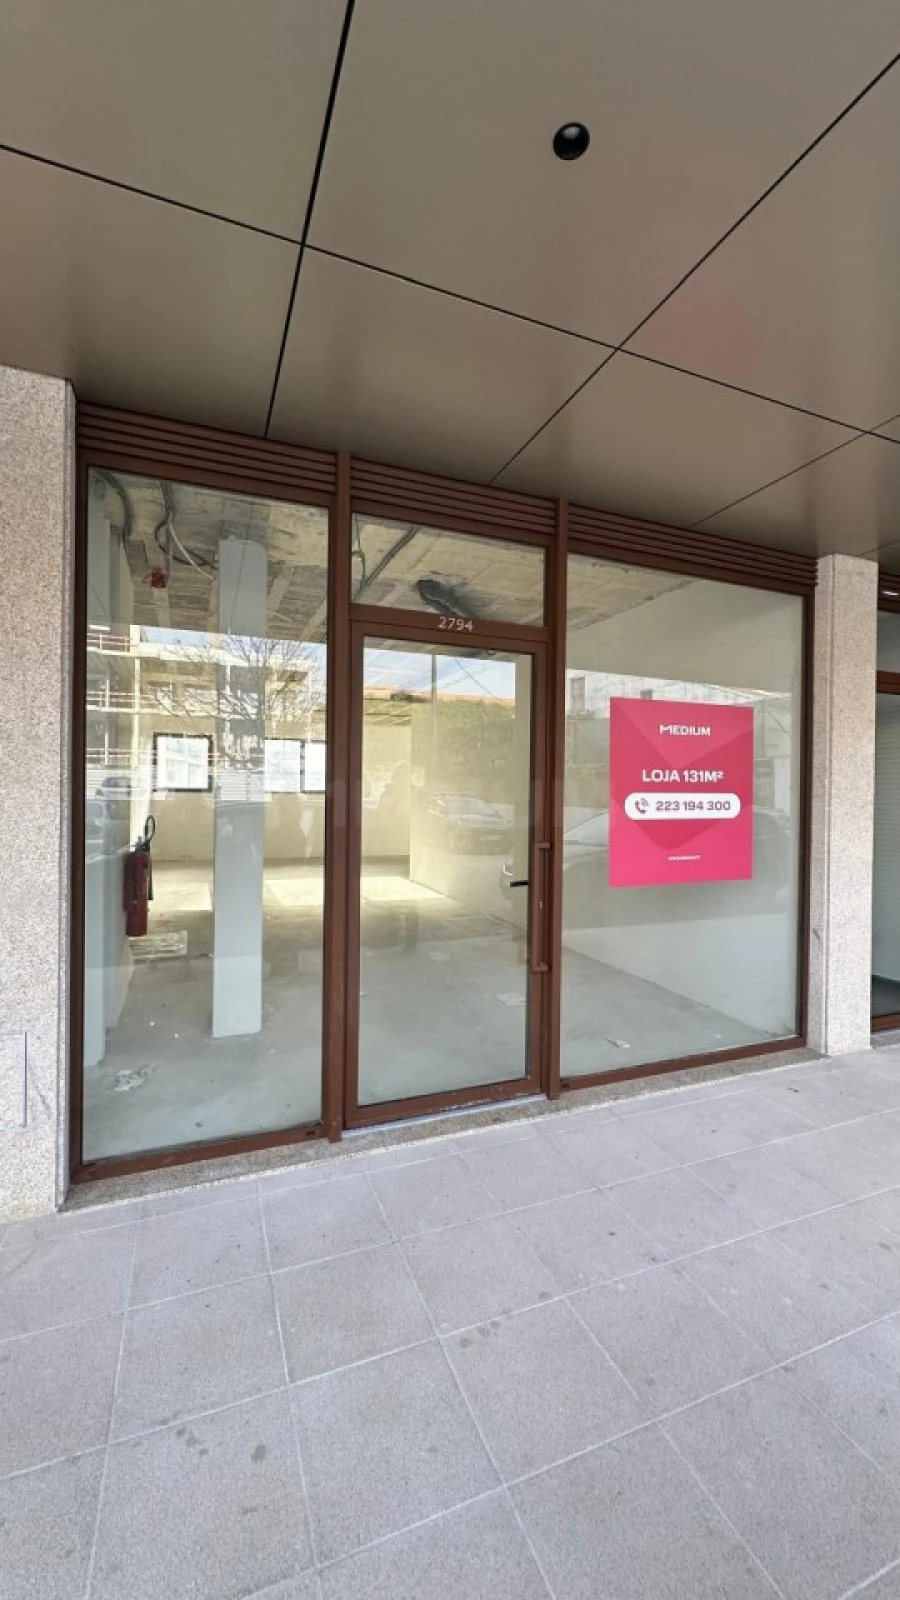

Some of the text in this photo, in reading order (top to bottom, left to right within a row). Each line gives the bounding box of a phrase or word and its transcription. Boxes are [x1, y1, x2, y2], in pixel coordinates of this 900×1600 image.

[438, 616, 474, 632] 2794
[659, 724, 711, 737] MEDIUM
[642, 769, 681, 783] LOJA
[656, 801, 731, 812] 223 194 300
